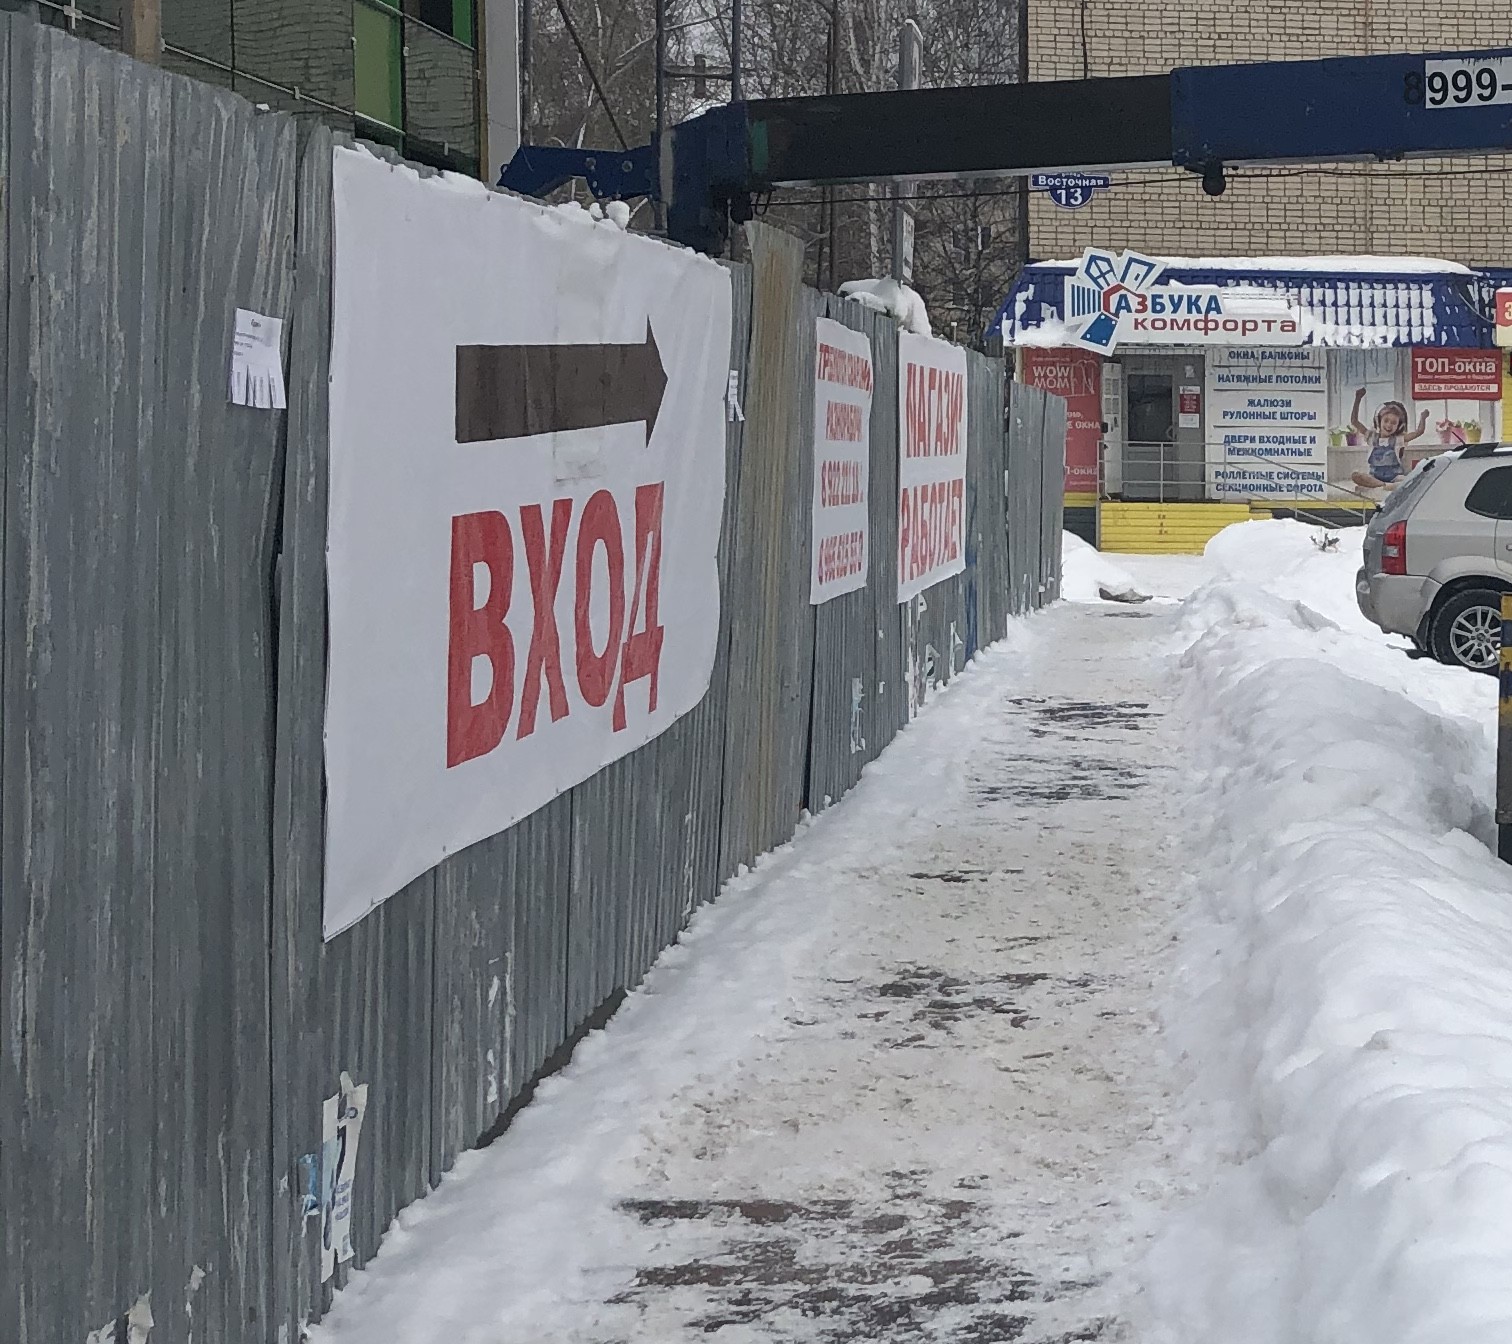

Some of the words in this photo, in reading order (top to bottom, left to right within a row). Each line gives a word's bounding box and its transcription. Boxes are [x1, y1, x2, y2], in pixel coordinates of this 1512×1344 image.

[1038, 175, 1104, 186] Восточная
[1056, 188, 1082, 205] 13
[1114, 293, 1223, 315] АЗБУКА
[1133, 315, 1297, 336] комфорта
[1261, 350, 1310, 361] БАЛКОНЫ
[1415, 357, 1496, 373] ТОП-окна
[1033, 366, 1070, 377] WOW
[1217, 374, 1273, 384] НАТЯЖНЫЕ
[1276, 374, 1321, 384] ПОТОЛКИ
[1247, 399, 1292, 408] ЖАЛЮЗИ
[1222, 411, 1278, 420] РУЛОННЫЕ
[1280, 411, 1317, 421] ШТОРЫ
[1224, 434, 1256, 444] ДВЕРИ
[1259, 435, 1307, 445] ВХОДНЫЕ
[1310, 435, 1316, 444] И
[1228, 447, 1313, 457] МЕЖКОМНАТНЫЕ
[1215, 470, 1274, 480] РОЛЛЕТНЫЕ
[1277, 471, 1325, 481] СИСТЕМЫ
[1216, 483, 1284, 493] СЕКЦИОННЫЕ
[1287, 484, 1324, 493] ВОРОТА
[901, 478, 964, 585] РАБОТАЕТ
[446, 481, 665, 769] ВХОД
